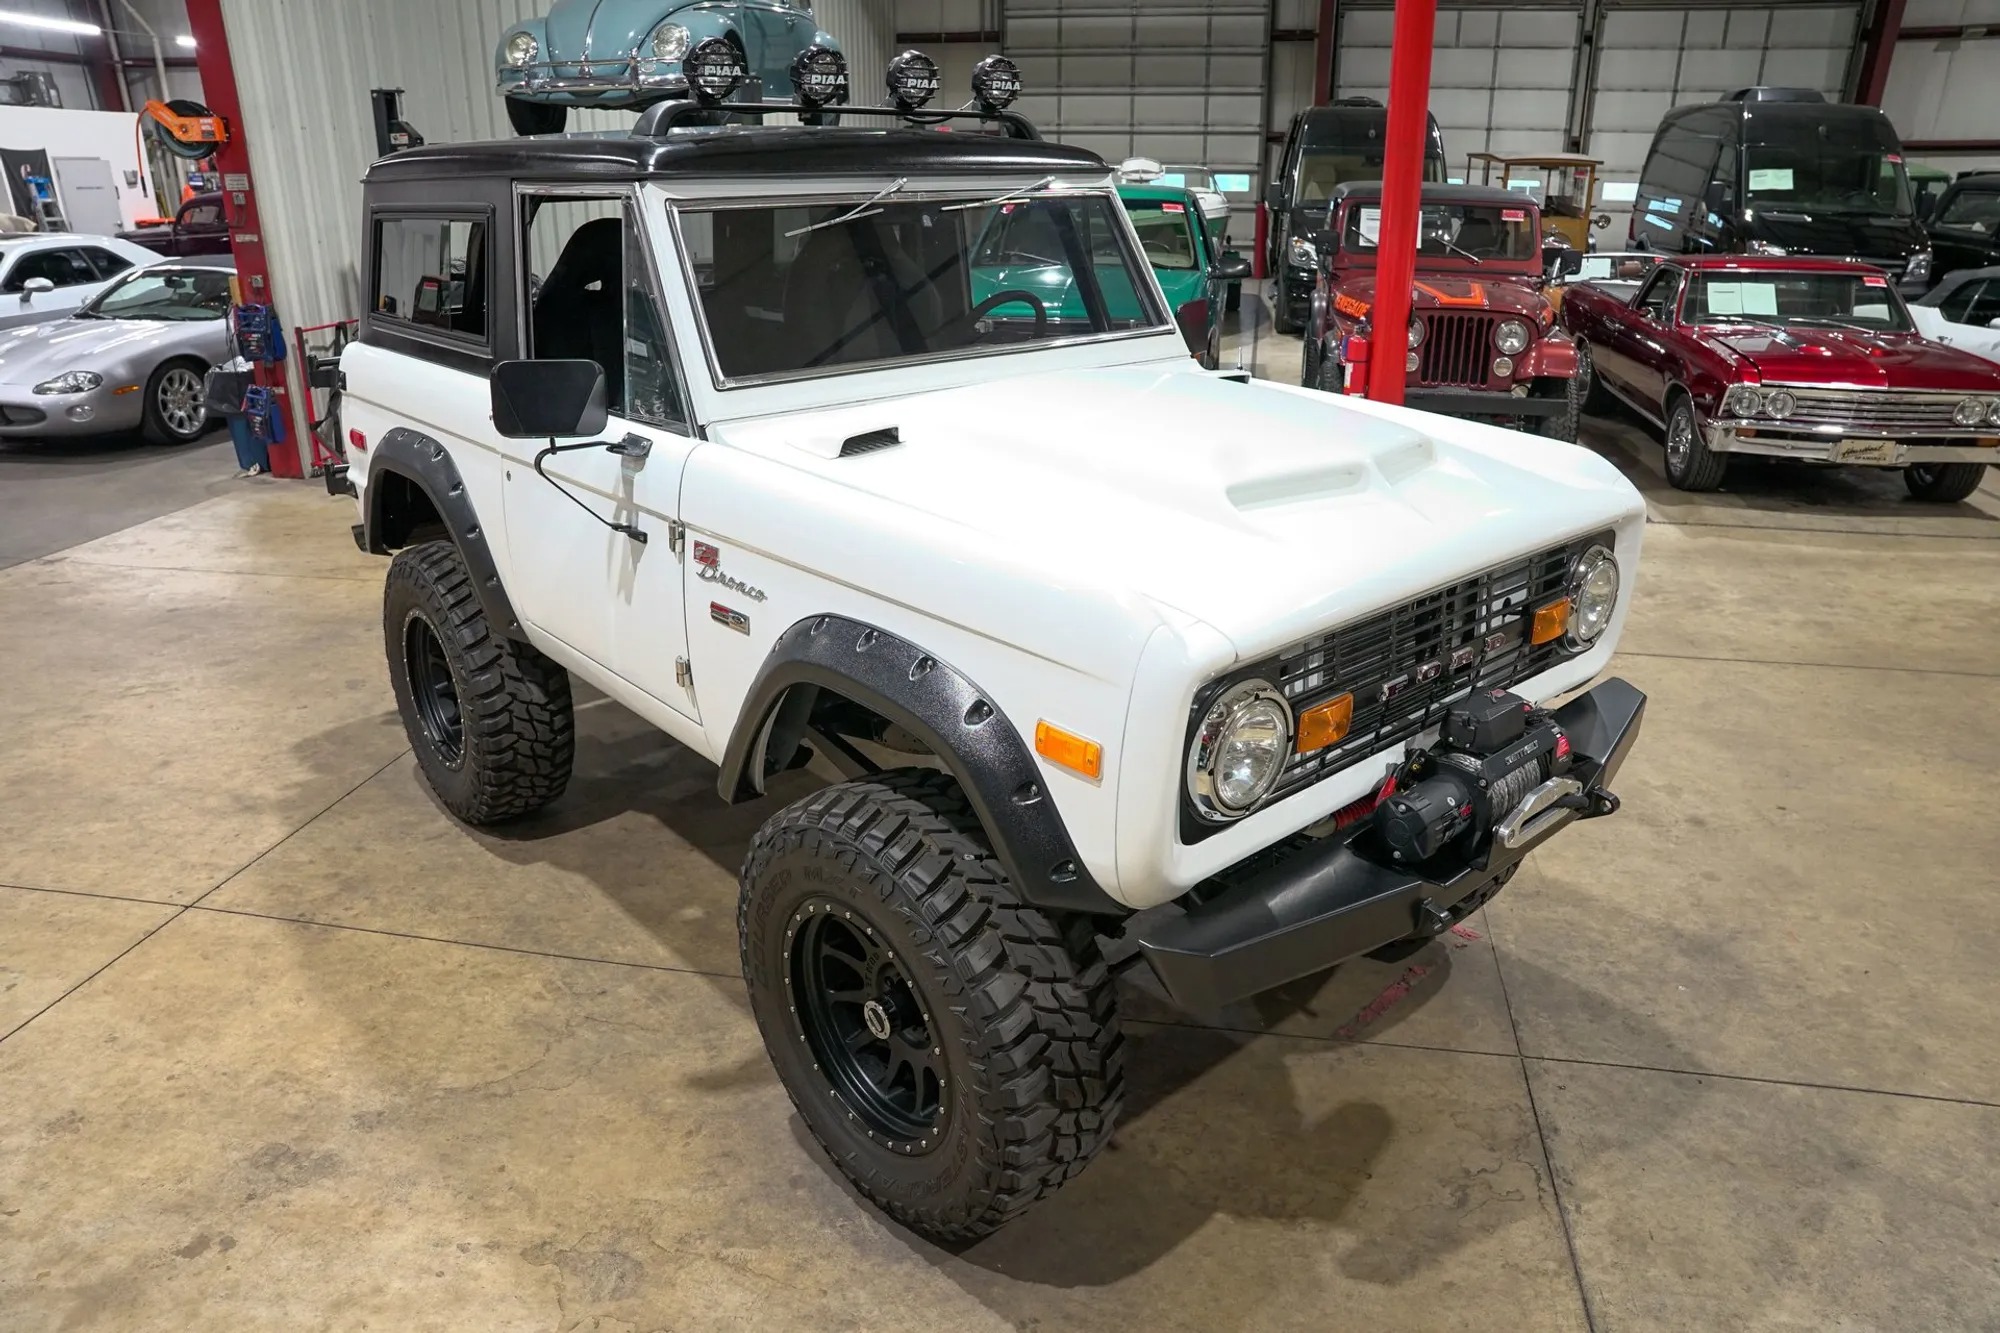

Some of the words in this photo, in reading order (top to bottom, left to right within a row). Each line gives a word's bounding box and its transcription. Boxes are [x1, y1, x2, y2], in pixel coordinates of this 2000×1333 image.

[704, 65, 742, 76] PIAA
[810, 74, 846, 85] PIAA
[907, 78, 939, 89] PIAA
[991, 80, 1021, 91] PIAA
[696, 557, 768, 603] Bronco
[1380, 632, 1507, 702] FORD
